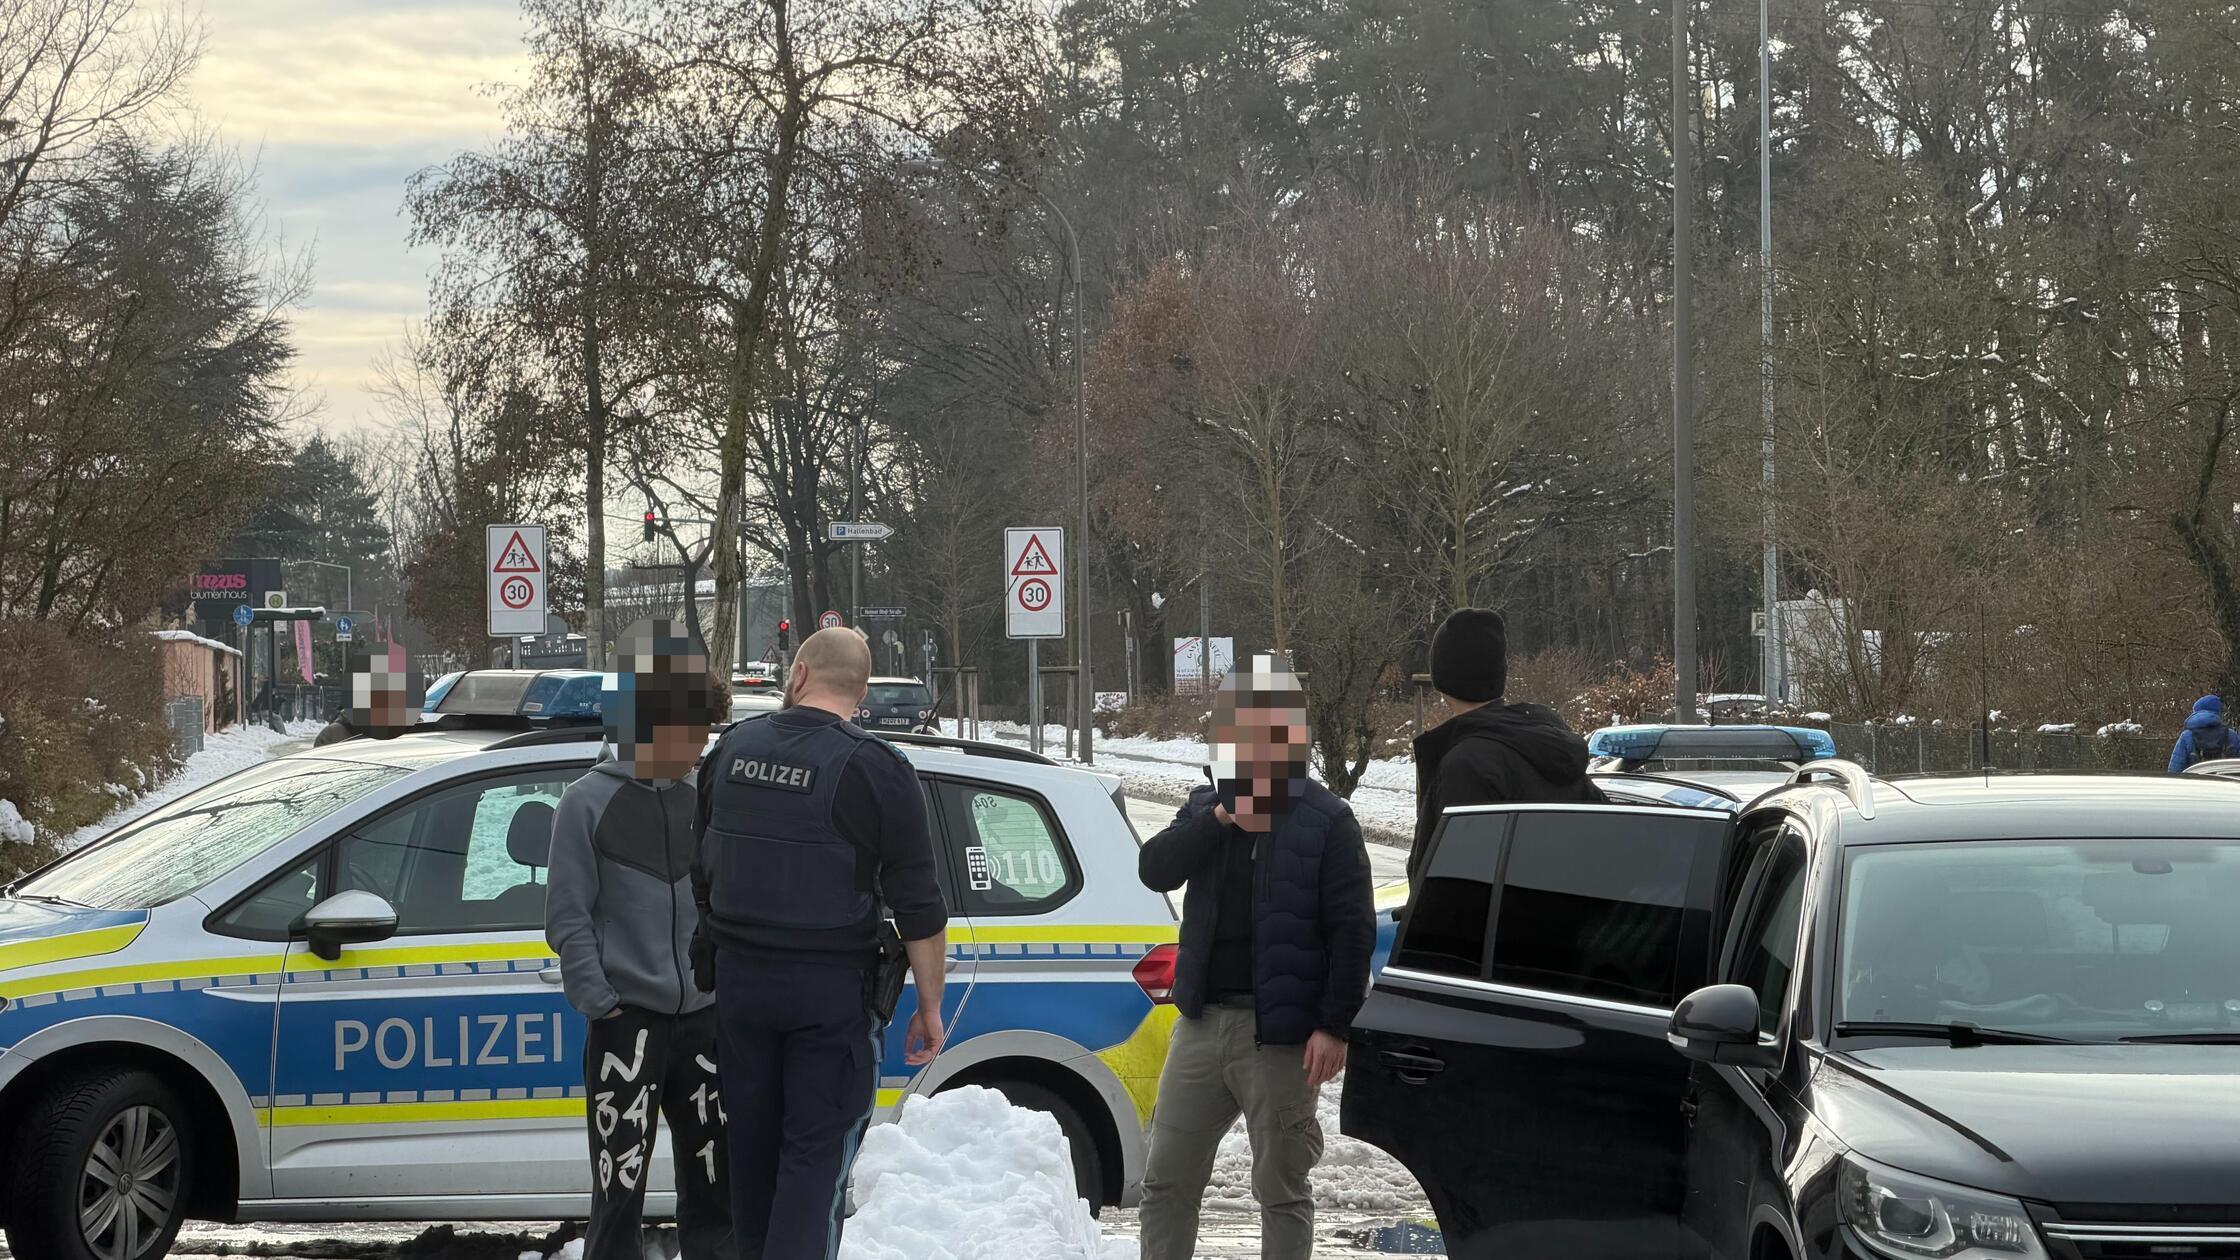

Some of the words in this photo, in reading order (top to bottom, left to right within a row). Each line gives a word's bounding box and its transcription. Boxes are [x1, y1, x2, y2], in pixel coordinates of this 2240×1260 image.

[847, 527, 883, 536] Hallenbad
[506, 584, 528, 600] 30
[1025, 587, 1045, 603] 30
[731, 758, 811, 787] POLIZEI
[1003, 850, 1056, 885] 110
[335, 1012, 562, 1071] POLIZEI
[600, 1029, 649, 1082] N
